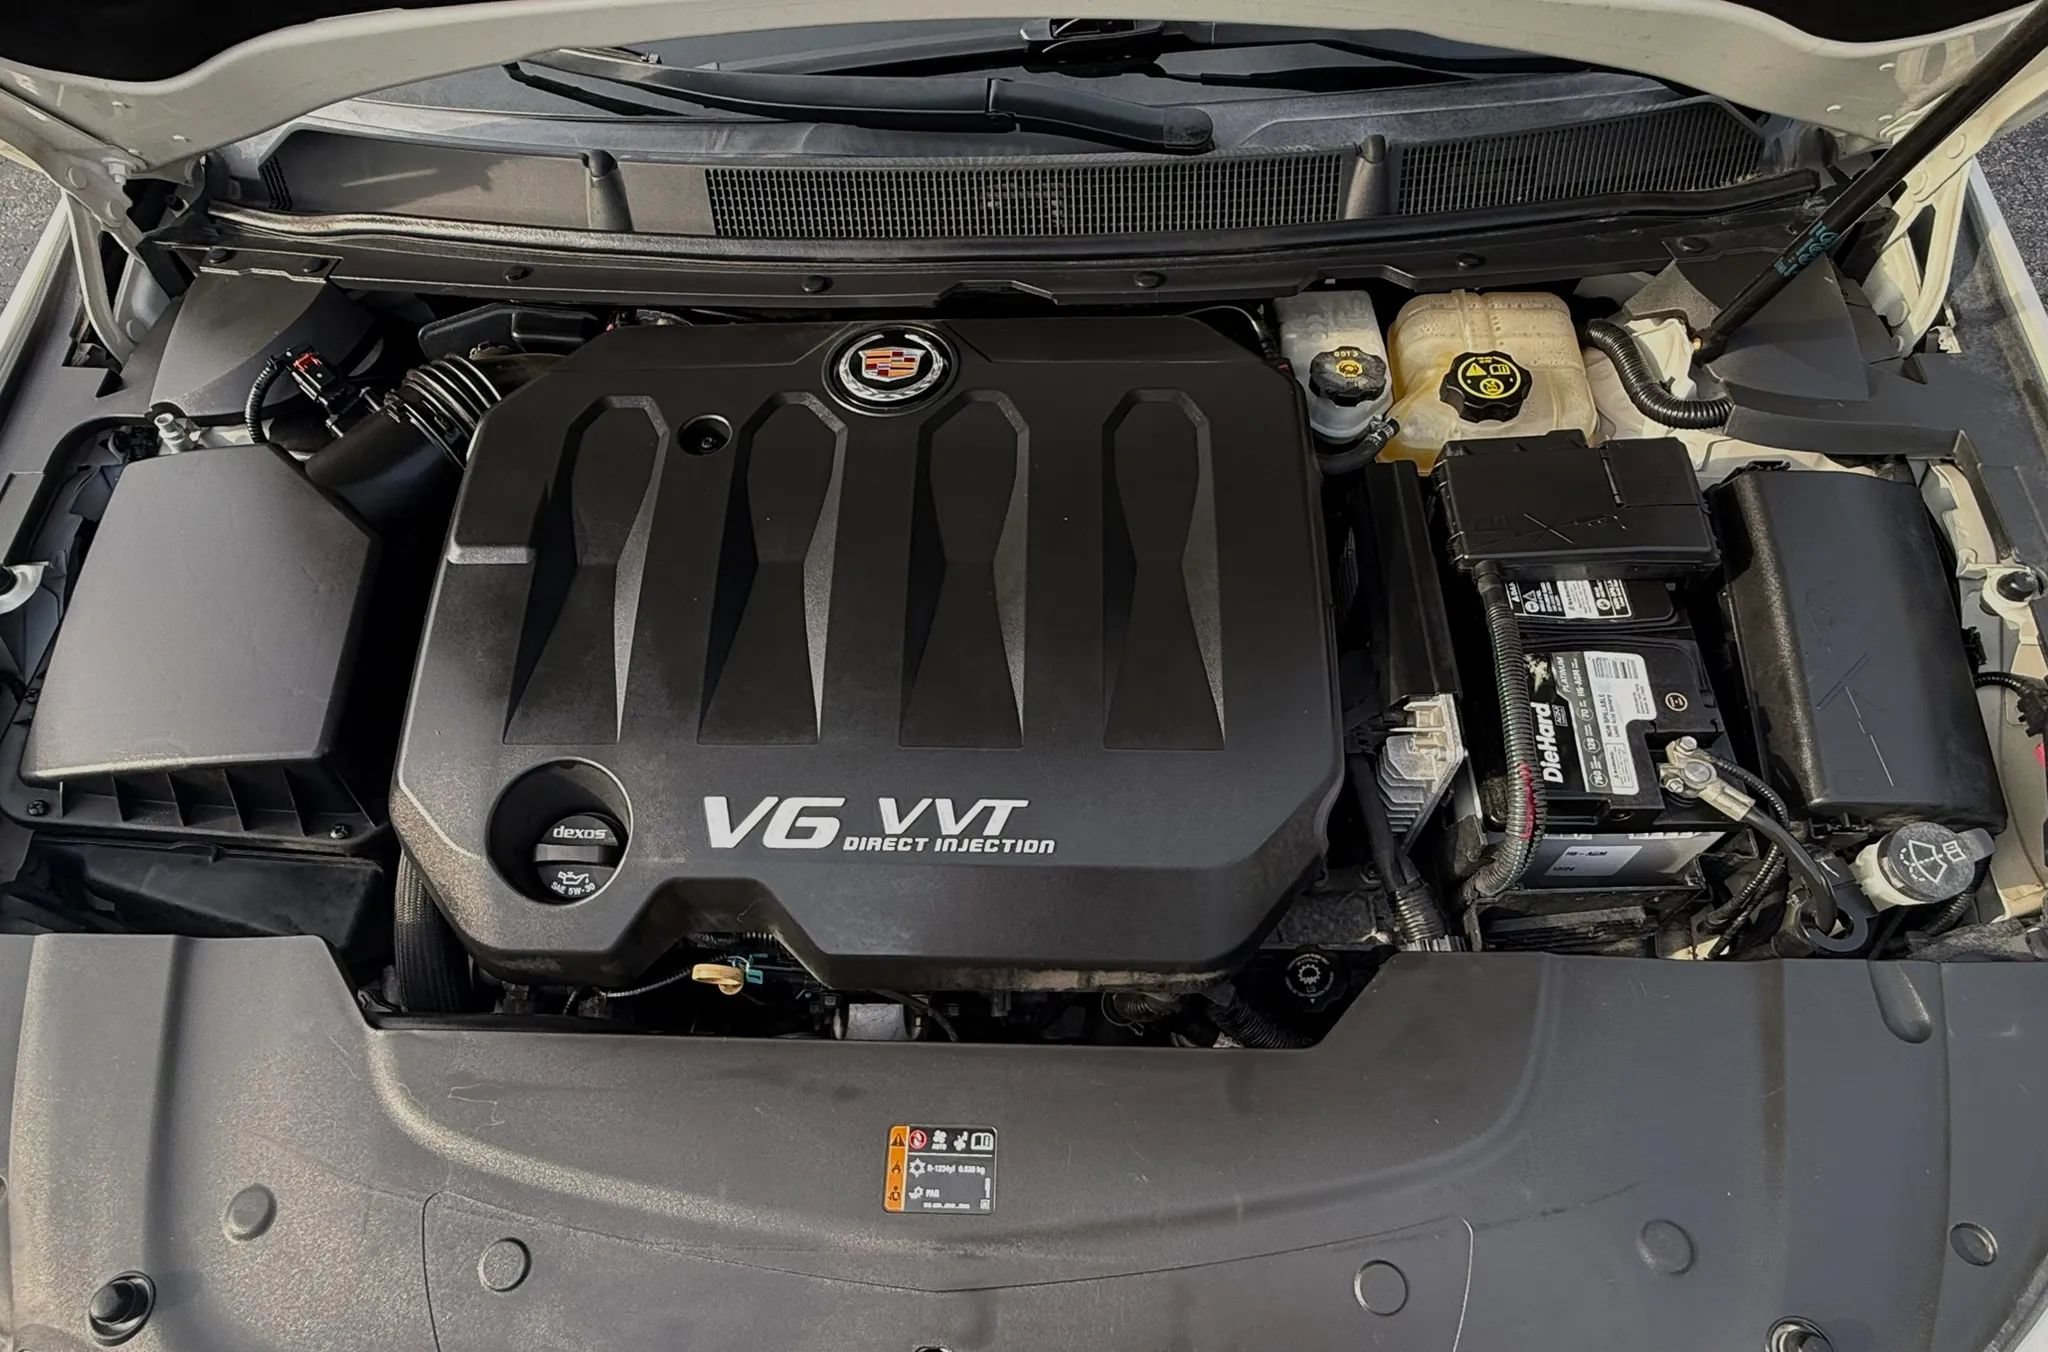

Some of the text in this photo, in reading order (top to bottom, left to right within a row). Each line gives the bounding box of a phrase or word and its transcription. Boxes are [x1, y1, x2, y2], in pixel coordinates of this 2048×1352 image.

[1556, 656, 1571, 693] PLATINUM
[1530, 701, 1564, 784] DieHard
[553, 825, 608, 839] dexos
[703, 795, 1030, 850] V6 VVT
[842, 836, 1056, 855] DIRECT INJECTION
[551, 882, 595, 895] SAE 5W-30
